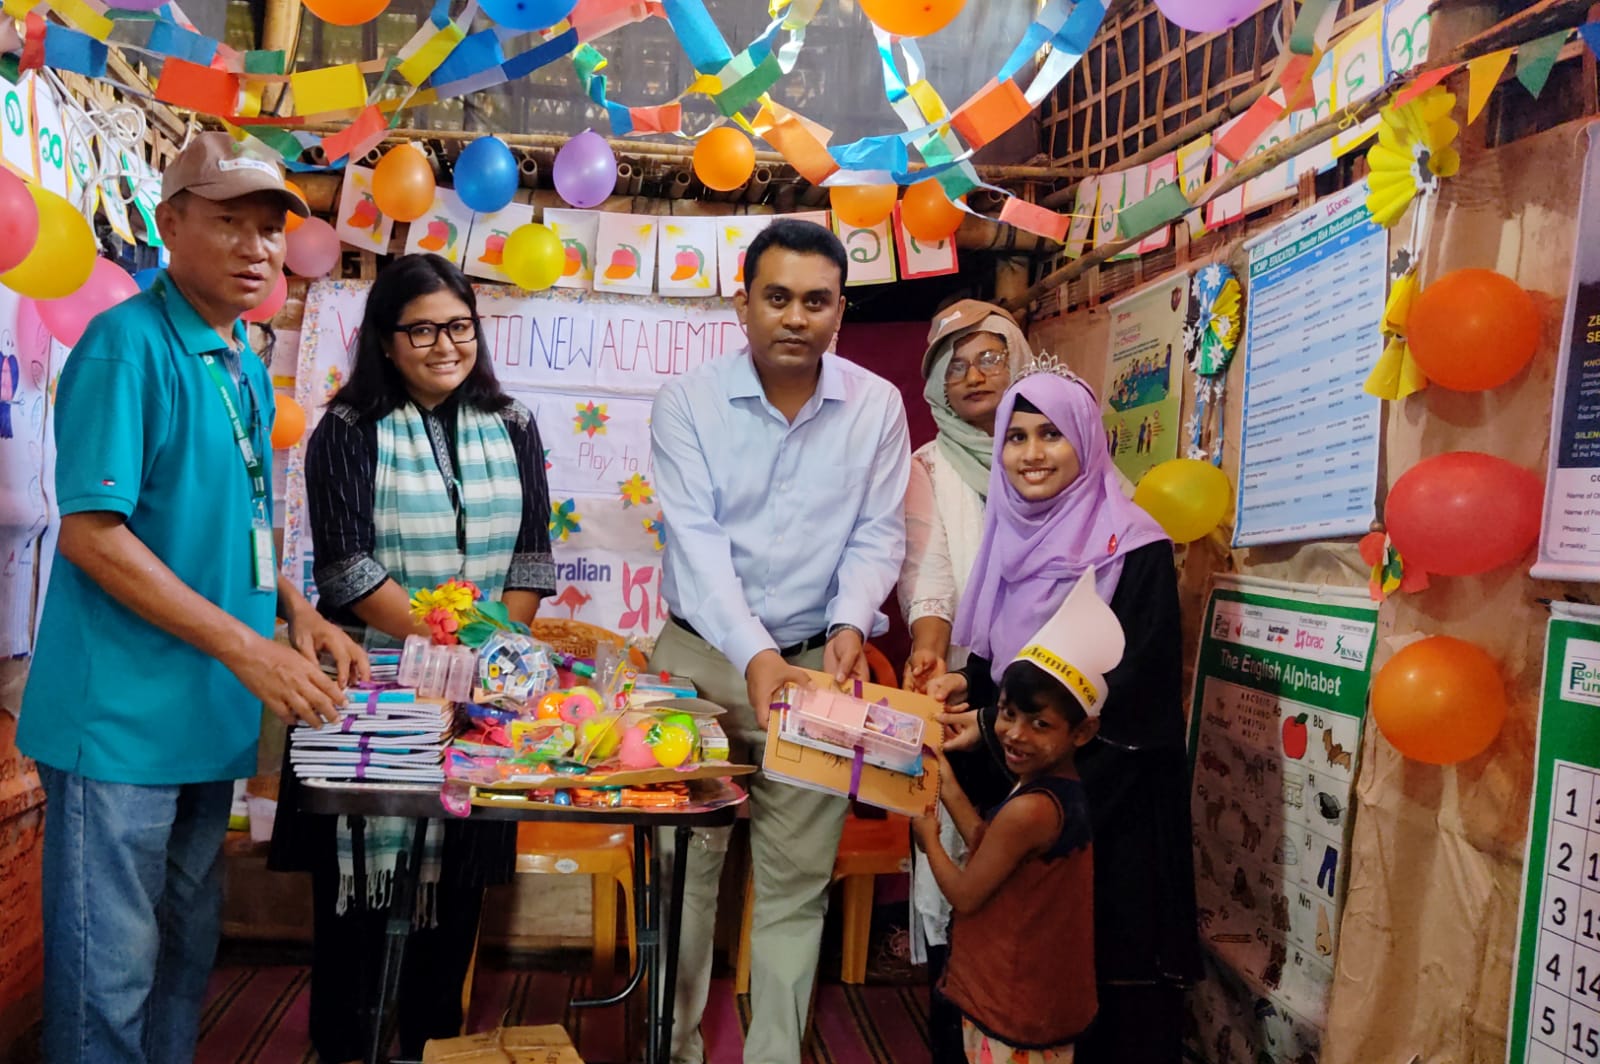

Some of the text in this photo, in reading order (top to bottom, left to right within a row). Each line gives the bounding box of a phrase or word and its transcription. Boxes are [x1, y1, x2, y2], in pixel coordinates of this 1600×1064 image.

[491, 314, 523, 366] TO
[529, 316, 595, 370] NEW
[623, 445, 638, 472] to
[557, 557, 611, 581] ralian
[1306, 632, 1325, 650] brac
[1221, 648, 1341, 697] The English Alphabet
[1313, 714, 1324, 729] Bb
[1566, 788, 1578, 818] 1
[1557, 842, 1600, 882] 2 1
[1299, 892, 1312, 911] Nn
[1552, 897, 1567, 926] 3
[1545, 953, 1600, 1001] 4 14
[1541, 1005, 1600, 1058] 5 15
